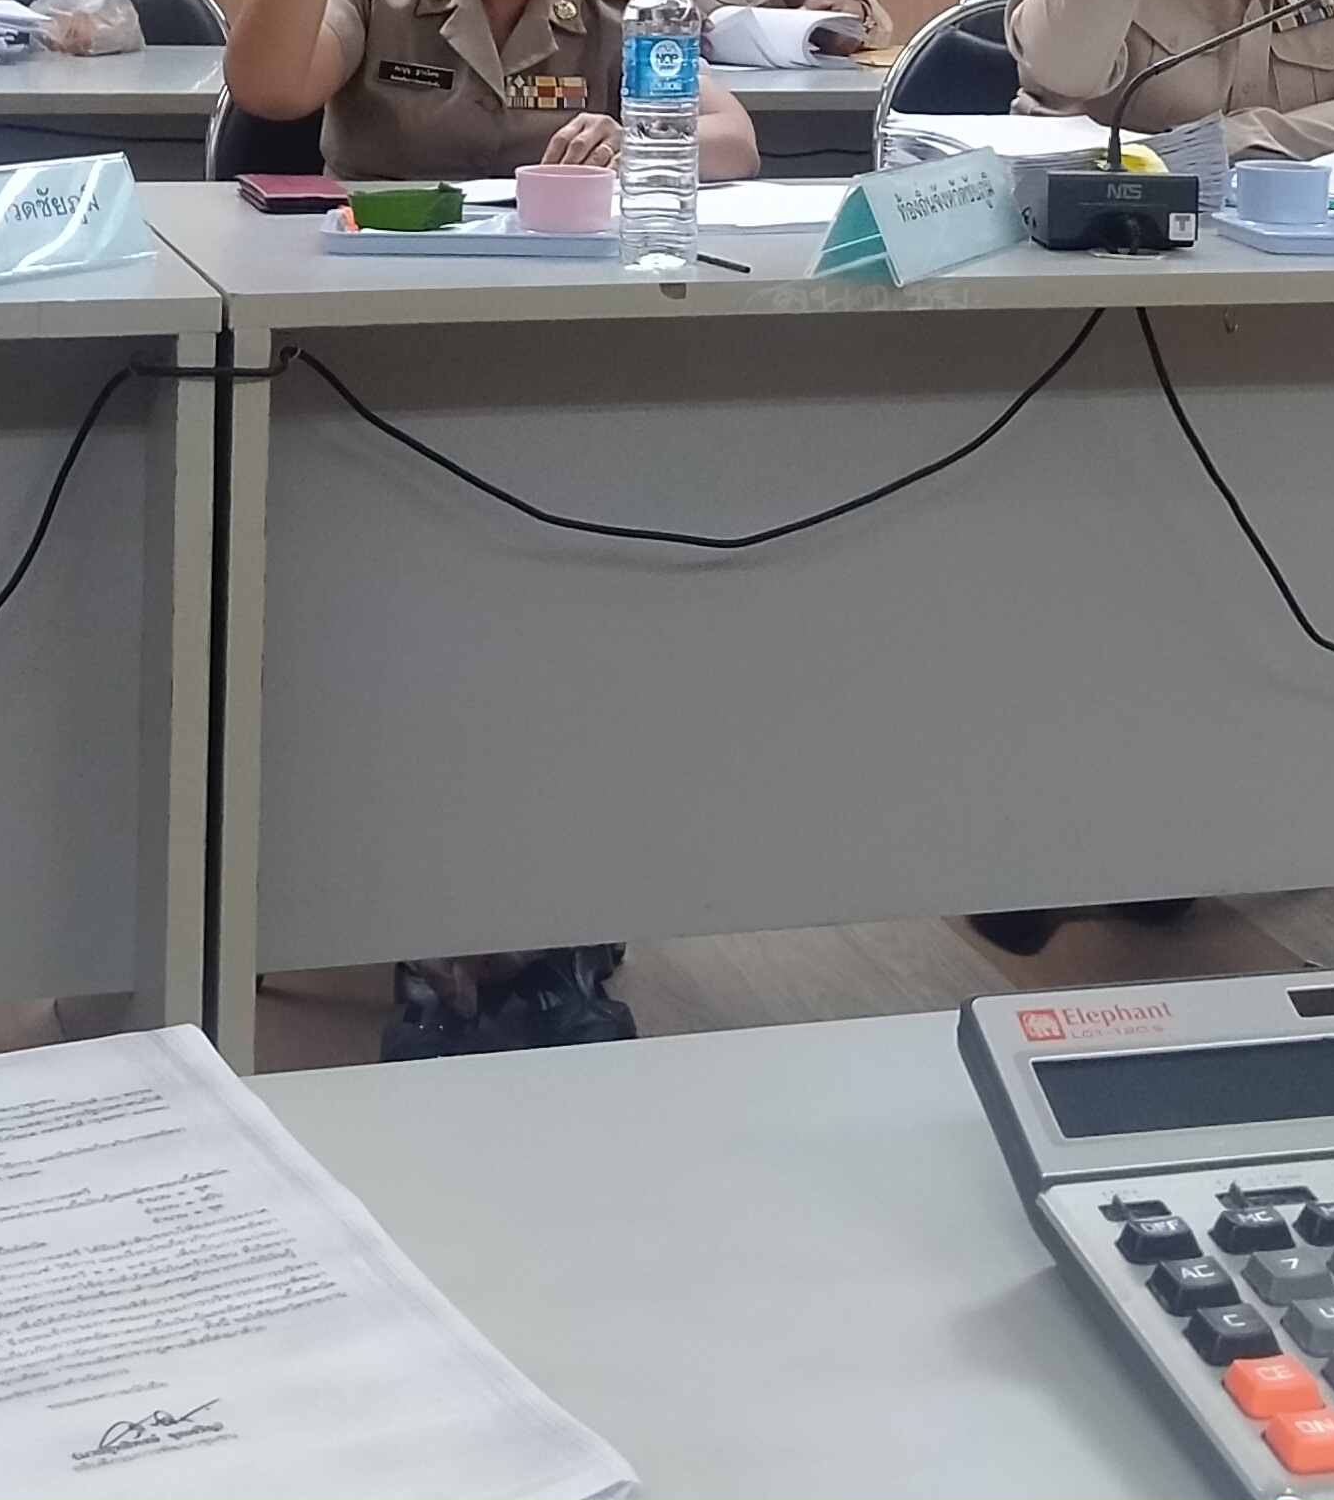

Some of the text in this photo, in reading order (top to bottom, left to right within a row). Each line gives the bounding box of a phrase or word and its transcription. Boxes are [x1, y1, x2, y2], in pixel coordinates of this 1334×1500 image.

[1062, 1002, 1172, 1027] Elephant
[1236, 1211, 1274, 1224] MC
[1140, 1219, 1179, 1233] OFF
[1280, 1258, 1299, 1270] 7
[1180, 1264, 1216, 1279] AC
[1223, 1314, 1246, 1328] C
[1255, 1365, 1295, 1381] CE
